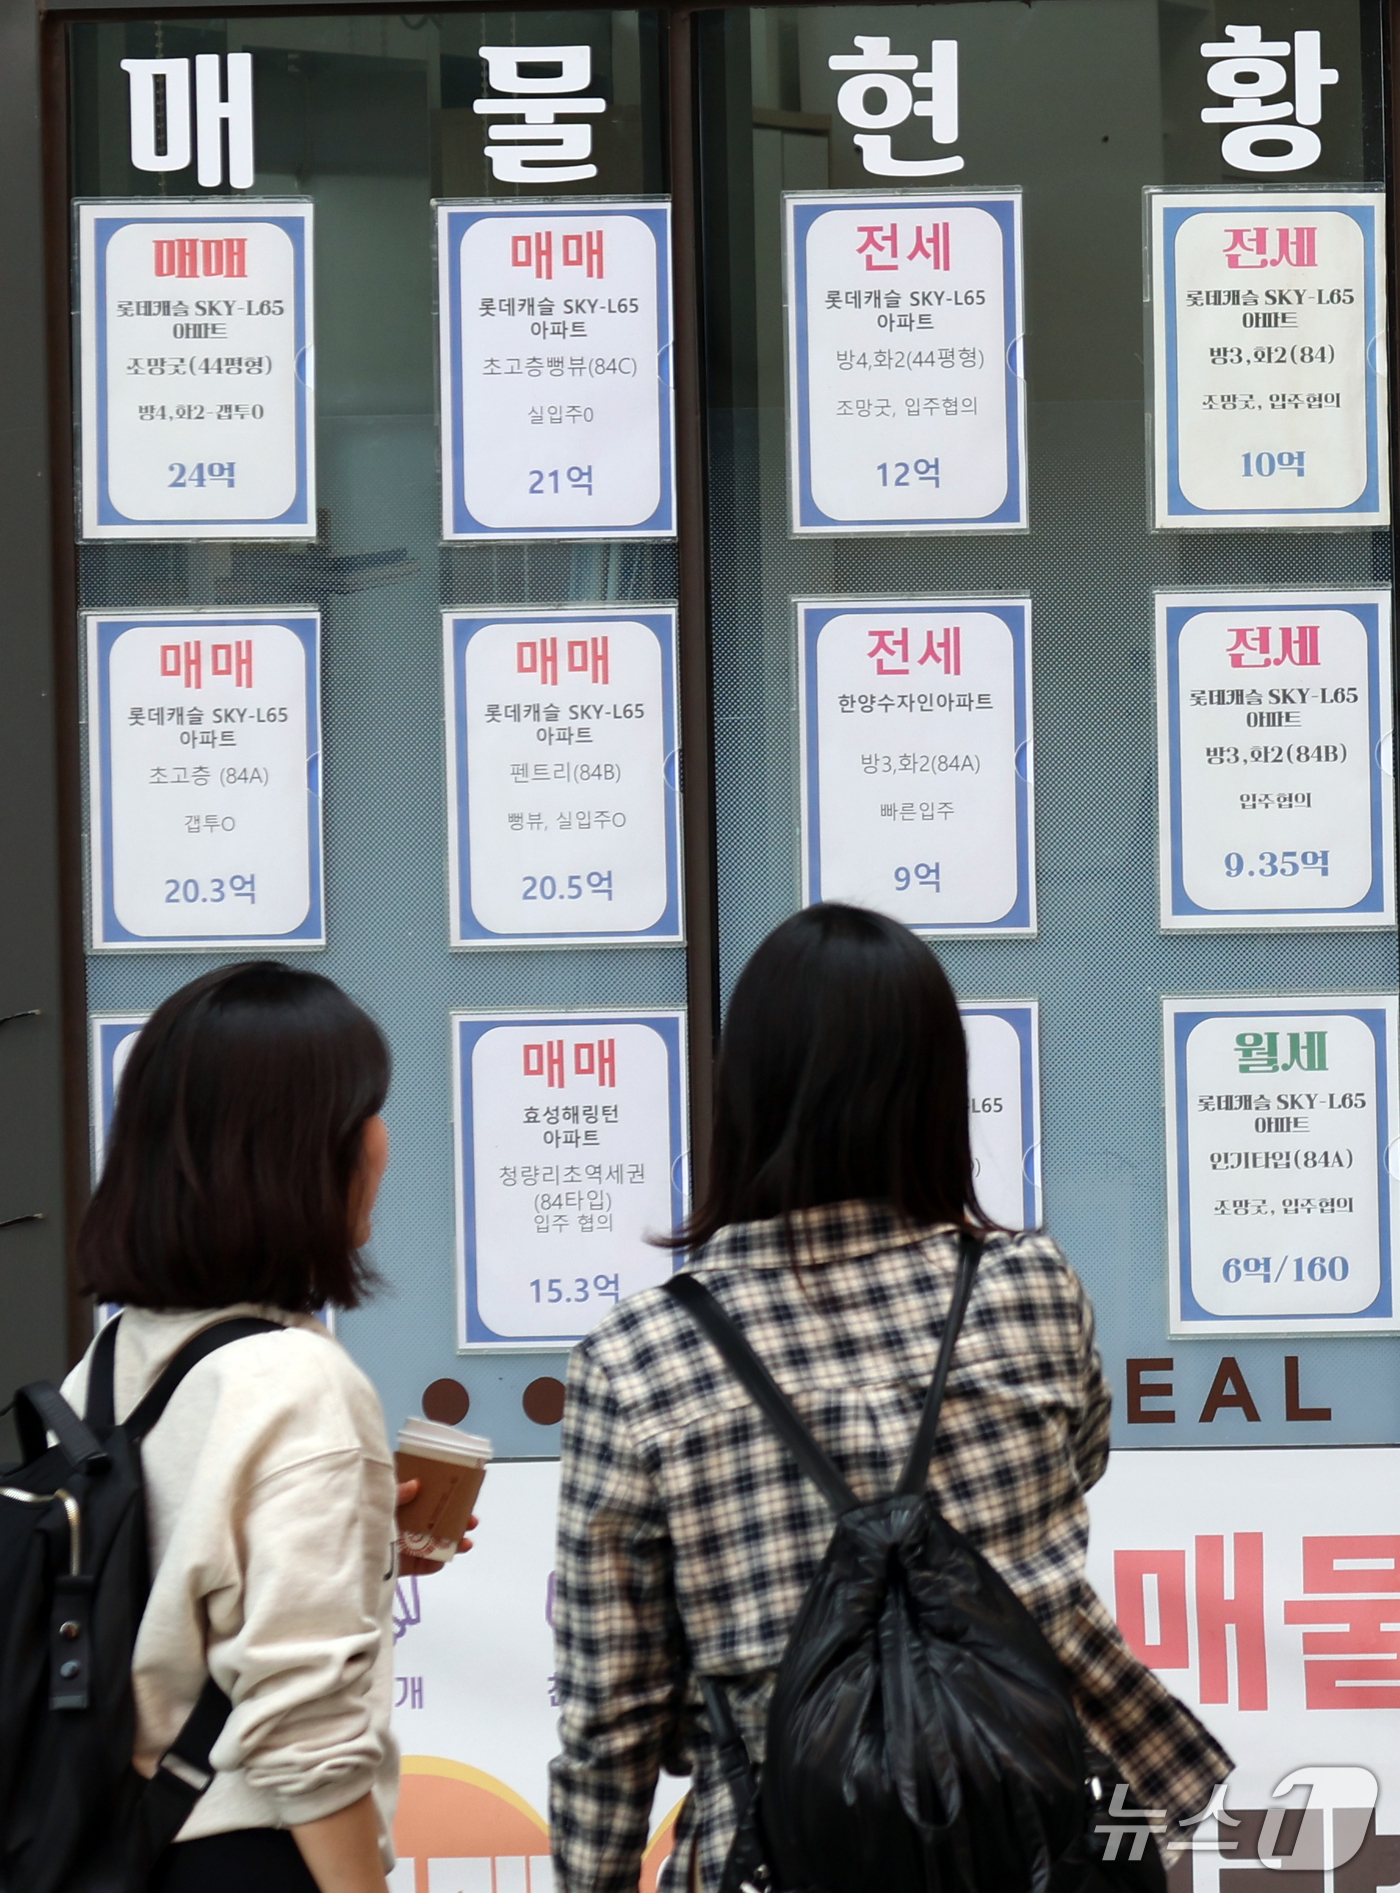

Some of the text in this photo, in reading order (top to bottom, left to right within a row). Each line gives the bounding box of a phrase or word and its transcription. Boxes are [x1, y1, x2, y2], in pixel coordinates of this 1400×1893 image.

[512, 230, 603, 280] 매매
[856, 222, 950, 271] 전세
[1223, 227, 1317, 268] 전세
[153, 238, 247, 278] 매매
[479, 297, 638, 317] 롯데캐슬 SKY-L65
[825, 290, 985, 309] 롯데캐슬 SKY-L65
[1187, 289, 1354, 306] 롯데캐슬 SKY-L65
[117, 300, 284, 317] 롯데캐슬 SKY-L65
[531, 321, 587, 340] 아파트
[878, 313, 934, 332] 아파트
[1243, 312, 1298, 328] 아파트
[173, 323, 227, 339] 아파트
[127, 356, 272, 375] 조망굿(44평형)
[837, 347, 984, 371] 방4,화2(44평형)
[1210, 345, 1334, 365] 방3,화2(84)
[483, 356, 637, 378] 초고층뻥뷰(84C)
[837, 397, 977, 417] 조망굿, 입주협의
[1203, 393, 1340, 410] 조망굿, 입주협의
[877, 458, 939, 488] 12억
[1242, 451, 1305, 477] 10억
[168, 462, 235, 488] 24억
[529, 465, 592, 496] 21억
[867, 627, 960, 675] 전세
[1226, 626, 1321, 668] 전세
[161, 640, 252, 689] 매매
[517, 636, 609, 685] 매매
[838, 693, 993, 713] 한양수자인아파트
[1190, 688, 1358, 706] 롯데캐슬 SKY-L65
[128, 707, 288, 726] 롯데캐슬 SKY-L65
[485, 703, 644, 723] 롯데캐슬 SKY-L65
[1247, 711, 1301, 727] 아파트
[180, 730, 236, 749] 아파트
[537, 726, 593, 745] 아파트
[862, 753, 980, 775] 방3,화2(84A)
[1206, 744, 1346, 765] 방3,화2(84B)
[149, 766, 268, 787] 초고층 (84A)
[510, 762, 620, 784] 펜트리(84B)
[881, 802, 954, 821] 빠른입주
[1240, 793, 1311, 809] 입주협의
[508, 813, 547, 831] 뻥뷰,
[1225, 851, 1329, 877] 9.35억
[522, 870, 612, 901] 20.5억
[894, 862, 940, 893] 9억
[165, 874, 255, 904] 20.3억
[1234, 1031, 1328, 1073] 월세
[523, 1039, 615, 1088] 매매
[969, 1095, 1003, 1115] L65
[1199, 1093, 1366, 1111] 롯데캐슬 SKY-L65
[523, 1105, 618, 1125] 효성해링턴
[1255, 1117, 1309, 1133] 아파트
[544, 1129, 600, 1148] 아파트
[1210, 1149, 1352, 1170] 인기타입(84A)
[500, 1163, 644, 1186] 청량리초역세권
[535, 1190, 611, 1213] (84타입)
[1215, 1198, 1353, 1215] 조망굿, 입주협의
[534, 1211, 612, 1233] 입주 협의
[1223, 1256, 1349, 1283] 6억/160
[530, 1273, 622, 1305] 15.3억
[1114, 1532, 1400, 1711] 매물
